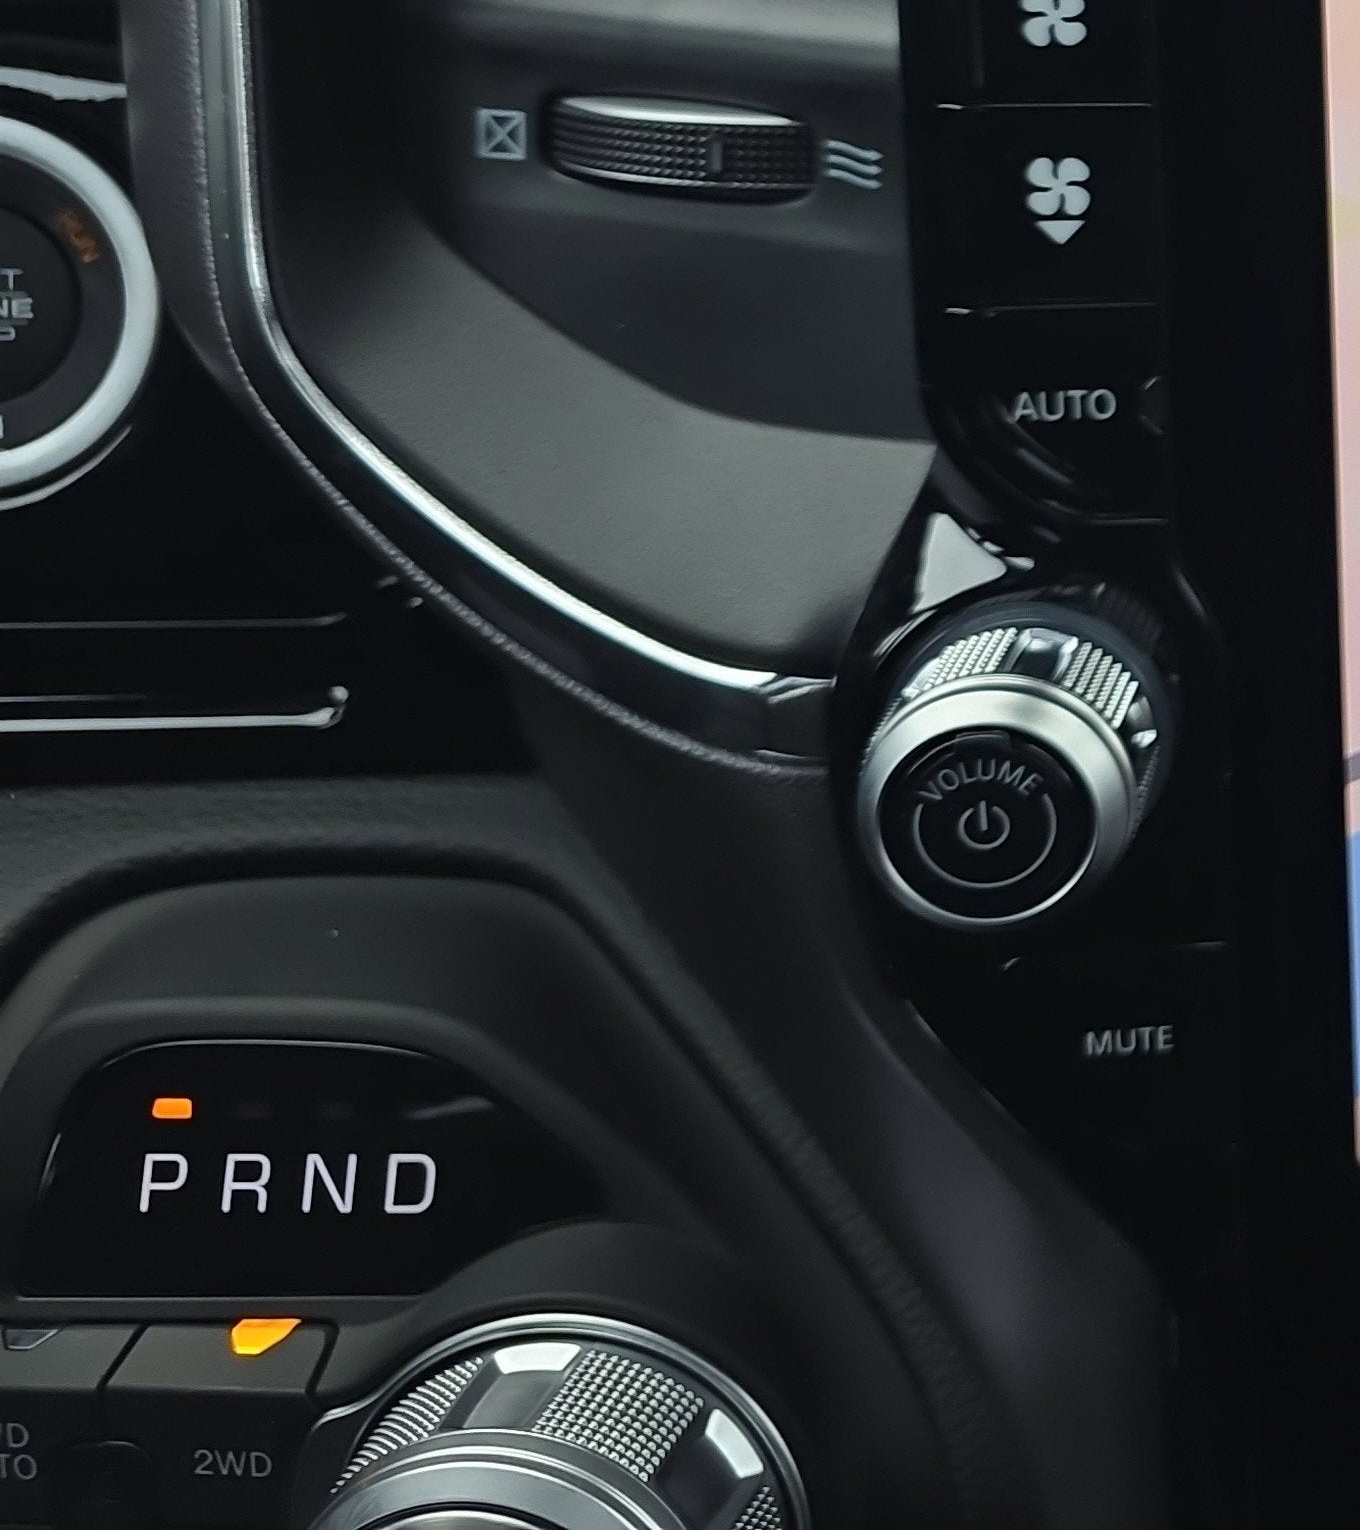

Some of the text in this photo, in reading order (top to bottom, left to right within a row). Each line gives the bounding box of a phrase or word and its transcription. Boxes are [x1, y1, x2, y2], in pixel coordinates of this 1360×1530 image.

[1014, 389, 1117, 423] AUTO
[918, 759, 1044, 804] VOLUME
[1083, 1025, 1175, 1057] MUTE
[194, 1449, 273, 1479] 2WD
